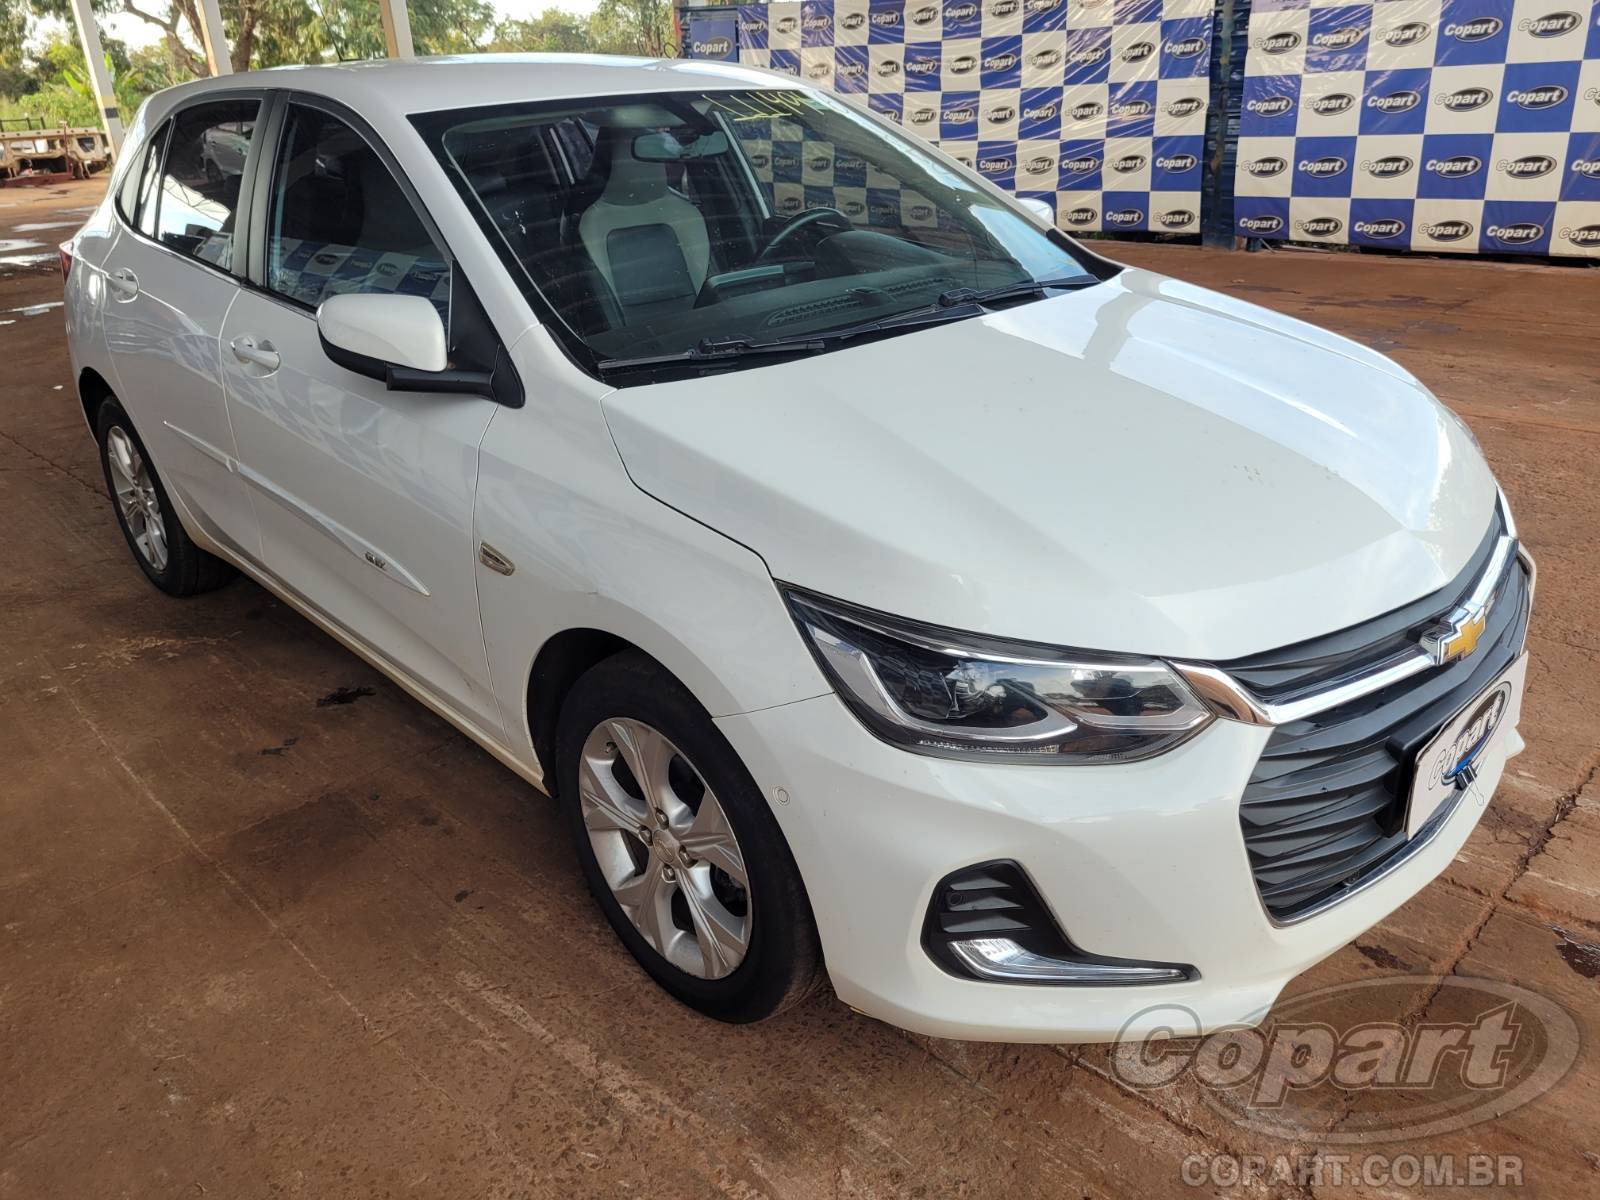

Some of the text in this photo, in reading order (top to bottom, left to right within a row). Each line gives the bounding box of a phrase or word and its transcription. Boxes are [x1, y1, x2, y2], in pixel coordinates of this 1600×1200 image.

[945, 8, 973, 19] Copart
[988, 4, 1014, 14] opart
[872, 14, 897, 25] Copart
[1518, 16, 1573, 33] Copart
[1376, 25, 1426, 42] Copart
[1445, 21, 1496, 37] Copart
[1313, 33, 1356, 46] Copart
[693, 40, 729, 55] Copart
[1165, 41, 1201, 54] Copart
[906, 62, 934, 73] Copart
[949, 61, 973, 71] opart
[984, 57, 1013, 69] Copart
[1305, 96, 1350, 112] Copart
[1367, 93, 1412, 109] Copart
[1435, 89, 1485, 107] Copart
[1507, 88, 1562, 106] Copart
[1023, 107, 1054, 119] Copart
[1111, 104, 1146, 117] Copart
[1247, 99, 1288, 113] Copart
[943, 110, 971, 121] Copart
[980, 160, 1010, 170] Copart
[1062, 158, 1096, 171] Copart
[1156, 156, 1193, 169] Copart
[1241, 159, 1283, 174] Copart
[1298, 159, 1343, 173] Copart
[1360, 158, 1406, 174] Copart
[1426, 157, 1474, 174] Copart
[1496, 157, 1548, 175] Copart
[1106, 210, 1139, 223] Copart
[1239, 216, 1280, 231] Copart
[1296, 218, 1338, 233] Copart
[1354, 219, 1401, 235] Copart
[1418, 222, 1468, 239] Copart
[1486, 223, 1539, 240] Copart
[1427, 690, 1503, 791] Copart
